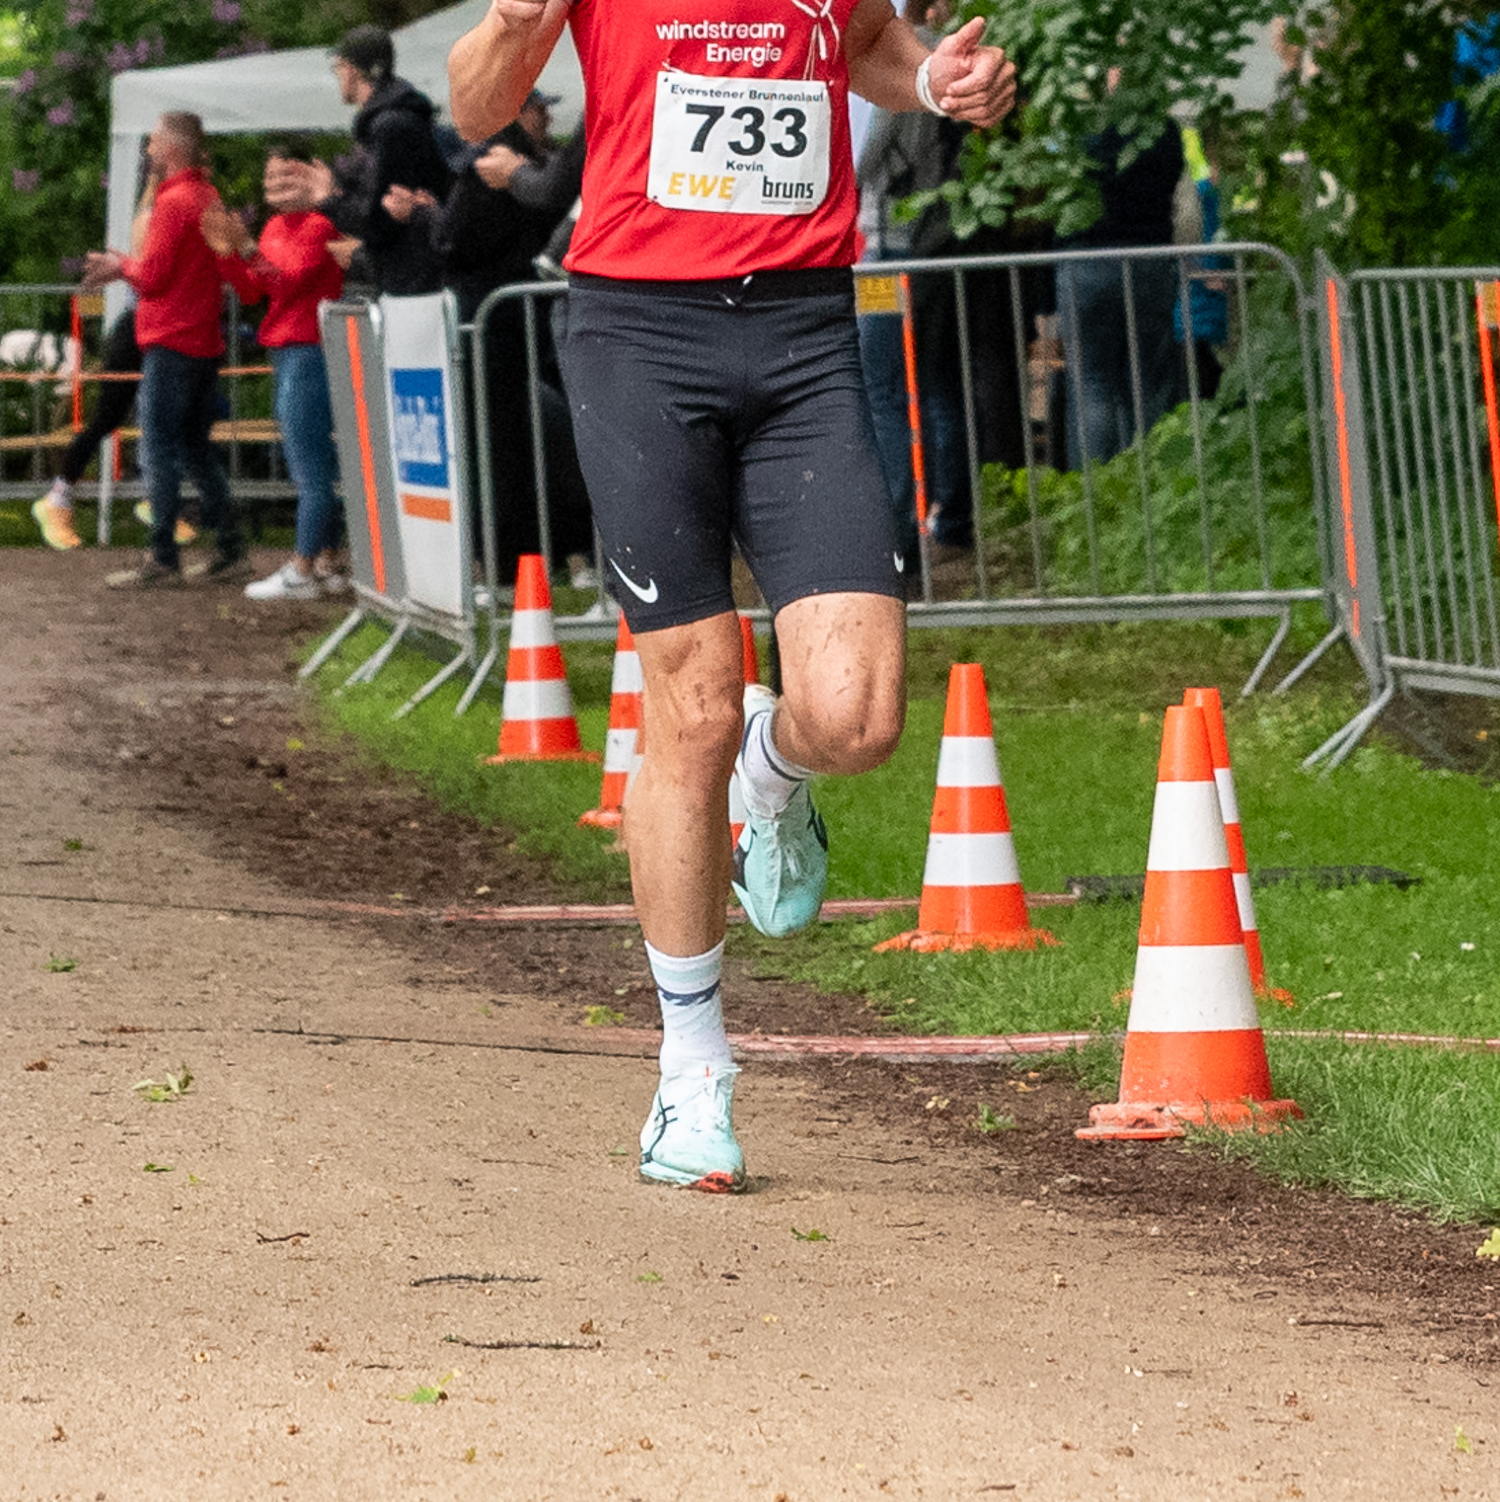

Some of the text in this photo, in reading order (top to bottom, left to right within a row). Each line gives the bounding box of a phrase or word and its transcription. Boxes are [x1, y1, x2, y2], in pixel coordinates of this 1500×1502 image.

[656, 19, 786, 40] windstream
[706, 42, 782, 67] Energie
[670, 84, 824, 102] Everstener Brunnenlauf
[685, 102, 808, 158] 733
[726, 159, 764, 172] Kevin
[667, 171, 814, 201] EWE bruns
